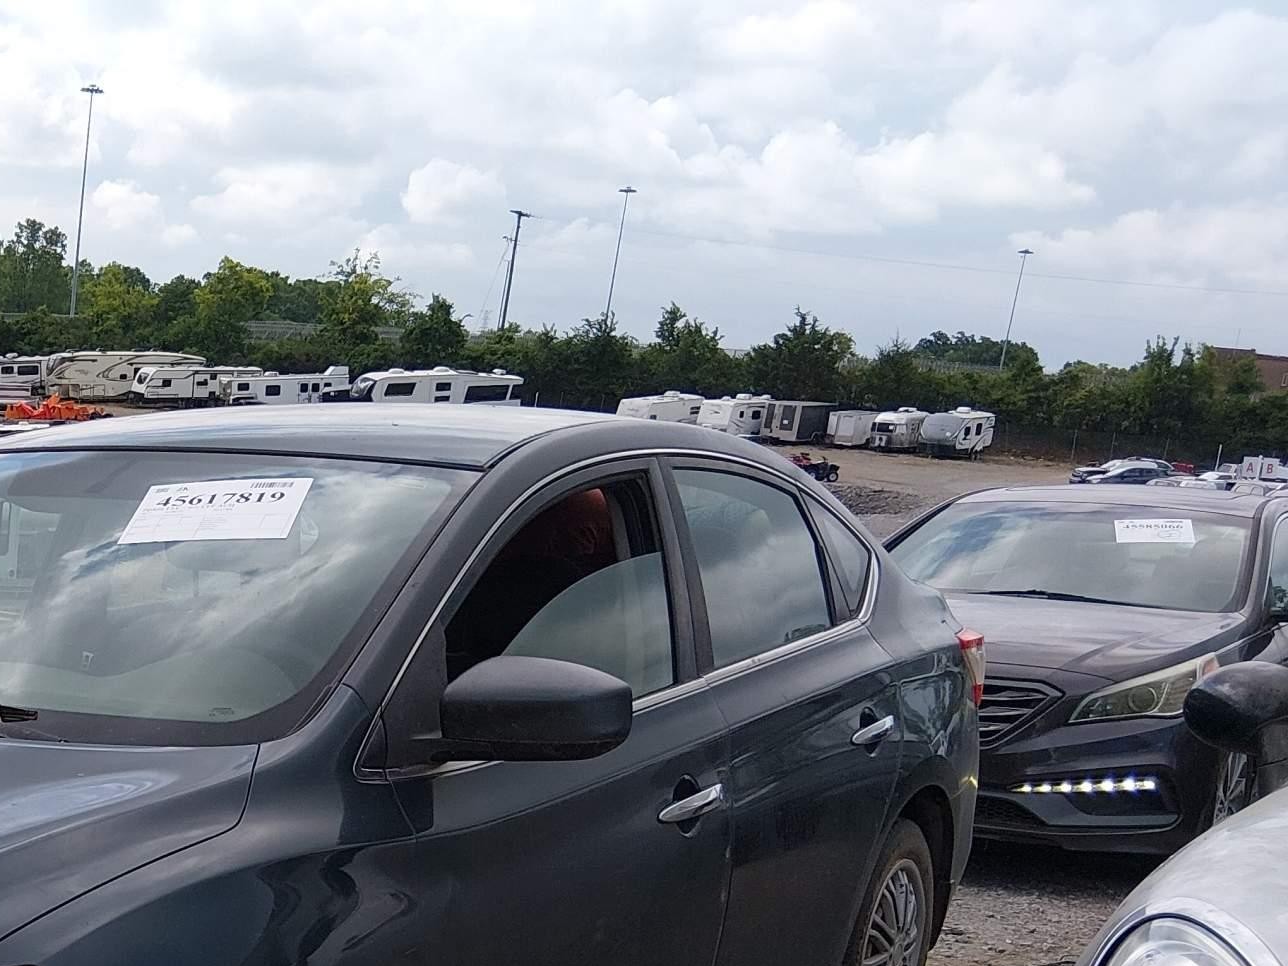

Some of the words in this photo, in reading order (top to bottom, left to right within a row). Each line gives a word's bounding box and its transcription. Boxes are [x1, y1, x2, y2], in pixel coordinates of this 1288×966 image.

[1245, 461, 1254, 473] A
[1266, 463, 1274, 474] B
[155, 491, 286, 507] 45617819
